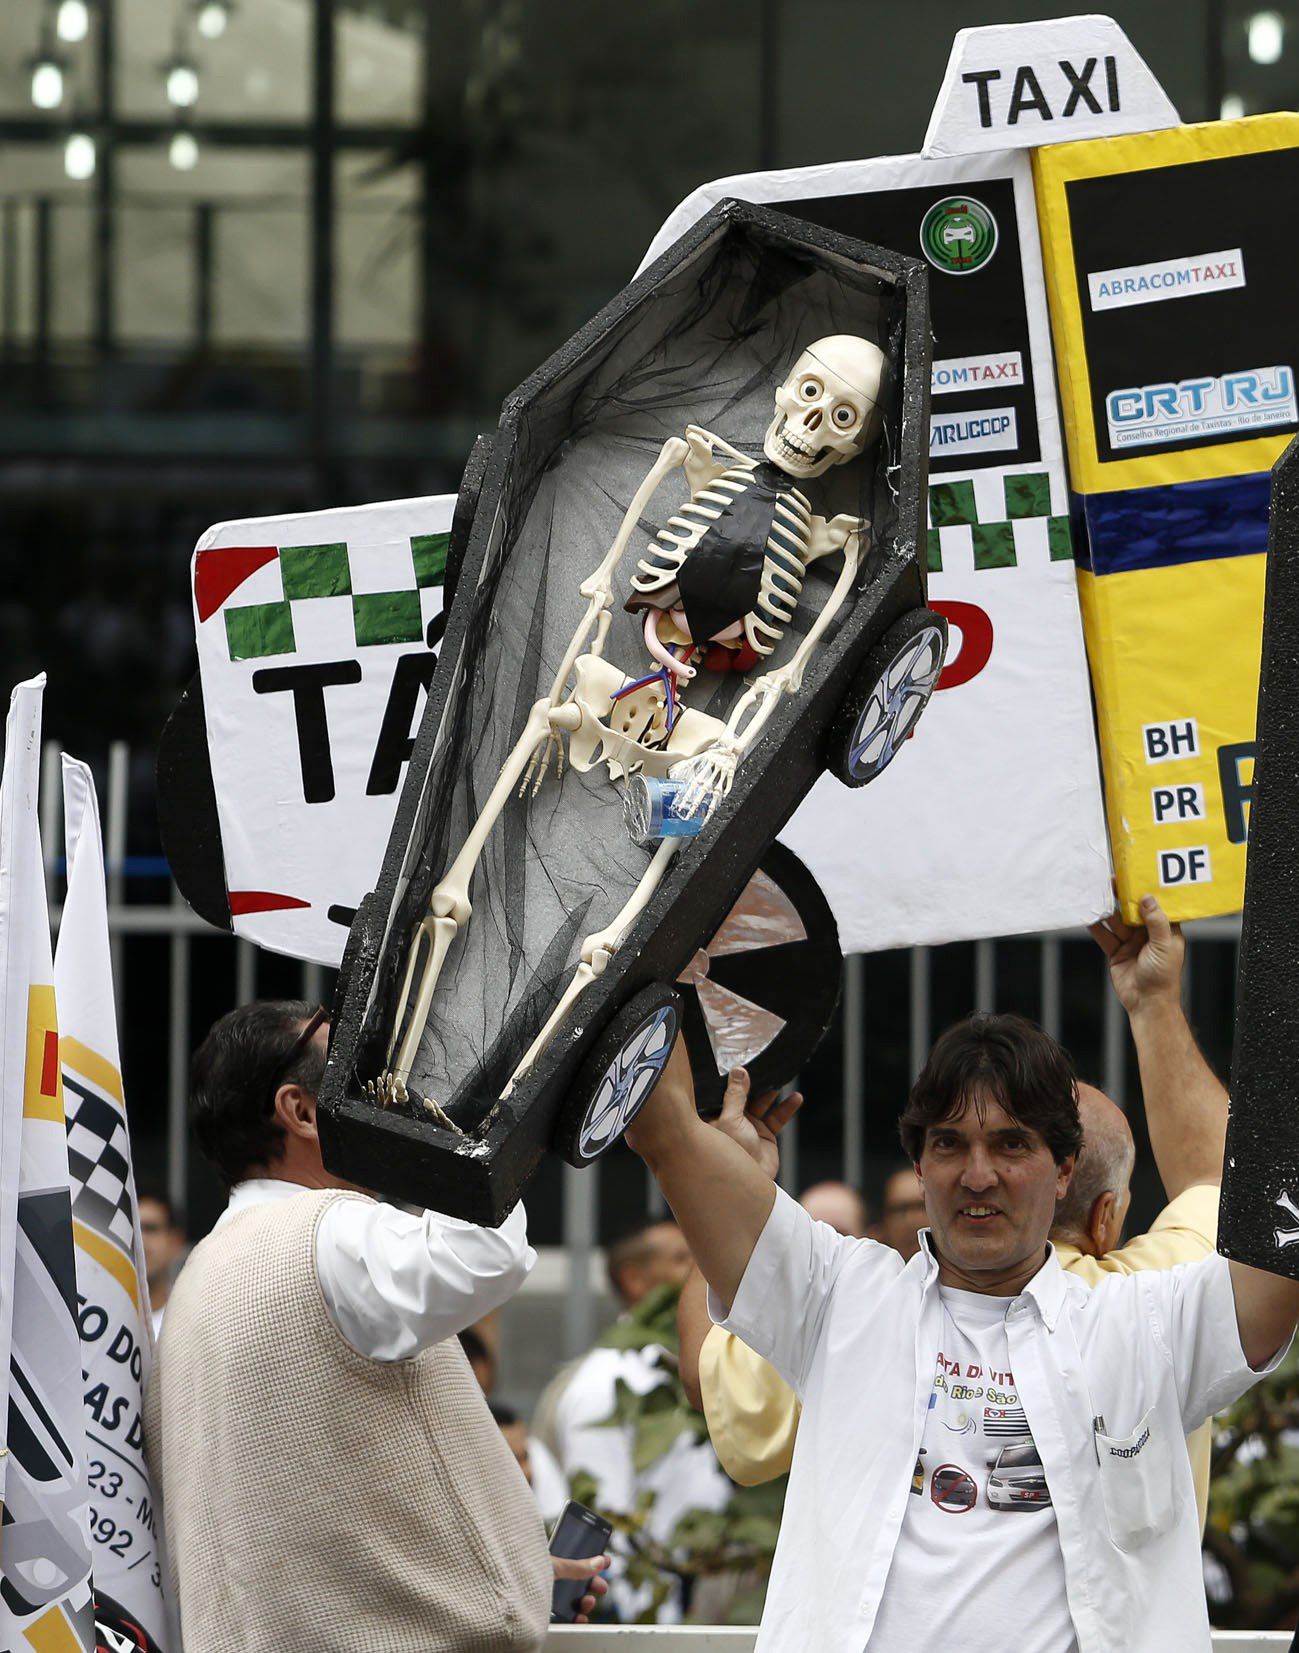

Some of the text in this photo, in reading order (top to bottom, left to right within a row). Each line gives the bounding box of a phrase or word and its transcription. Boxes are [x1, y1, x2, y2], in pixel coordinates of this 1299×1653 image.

[962, 56, 1120, 127] TAXI
[1098, 262, 1237, 297] ABRACOMTAXI
[1110, 370, 1290, 422] CRT RJ
[930, 416, 1010, 447] ARUCOOP
[1116, 429, 1153, 442] Conselho
[1154, 424, 1188, 437] Regional
[1189, 423, 1199, 432] de
[1201, 419, 1232, 430] Taxistas
[1237, 415, 1250, 424] Rio
[1251, 413, 1262, 421] de
[1263, 410, 1291, 421] Janeiro
[252, 651, 438, 803] TA
[1144, 721, 1196, 759] BH
[1153, 786, 1201, 822] PR
[1160, 848, 1206, 885] DF
[106, 1324, 142, 1390] DO
[936, 1352, 961, 1376] ATA
[988, 1366, 1015, 1386] VIT
[82, 1368, 130, 1430] AS
[951, 1385, 975, 1400] Rio
[986, 1387, 1019, 1405] São
[87, 1453, 123, 1498] 23
[151, 1562, 164, 1600] 3
